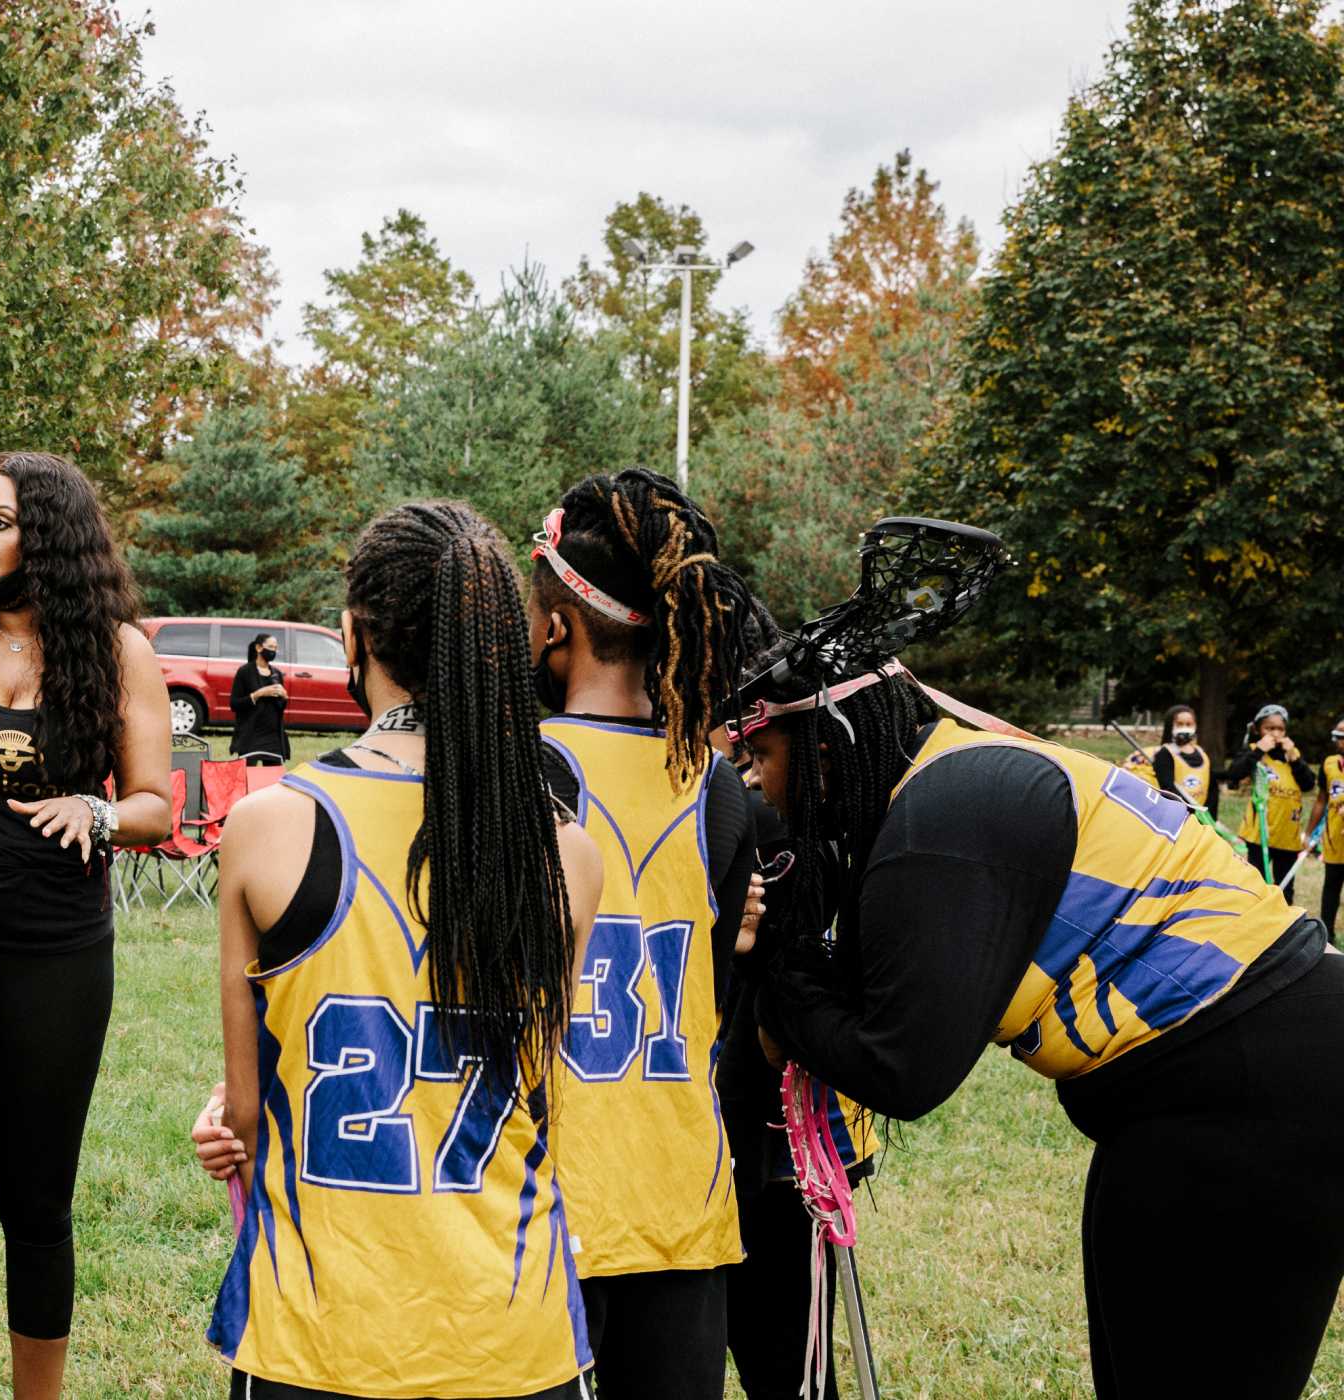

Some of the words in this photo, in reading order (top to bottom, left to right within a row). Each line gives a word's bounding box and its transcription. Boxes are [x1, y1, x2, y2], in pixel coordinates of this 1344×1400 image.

[561, 569, 596, 599] STX
[558, 914, 695, 1083] 31
[300, 993, 525, 1195] 27
